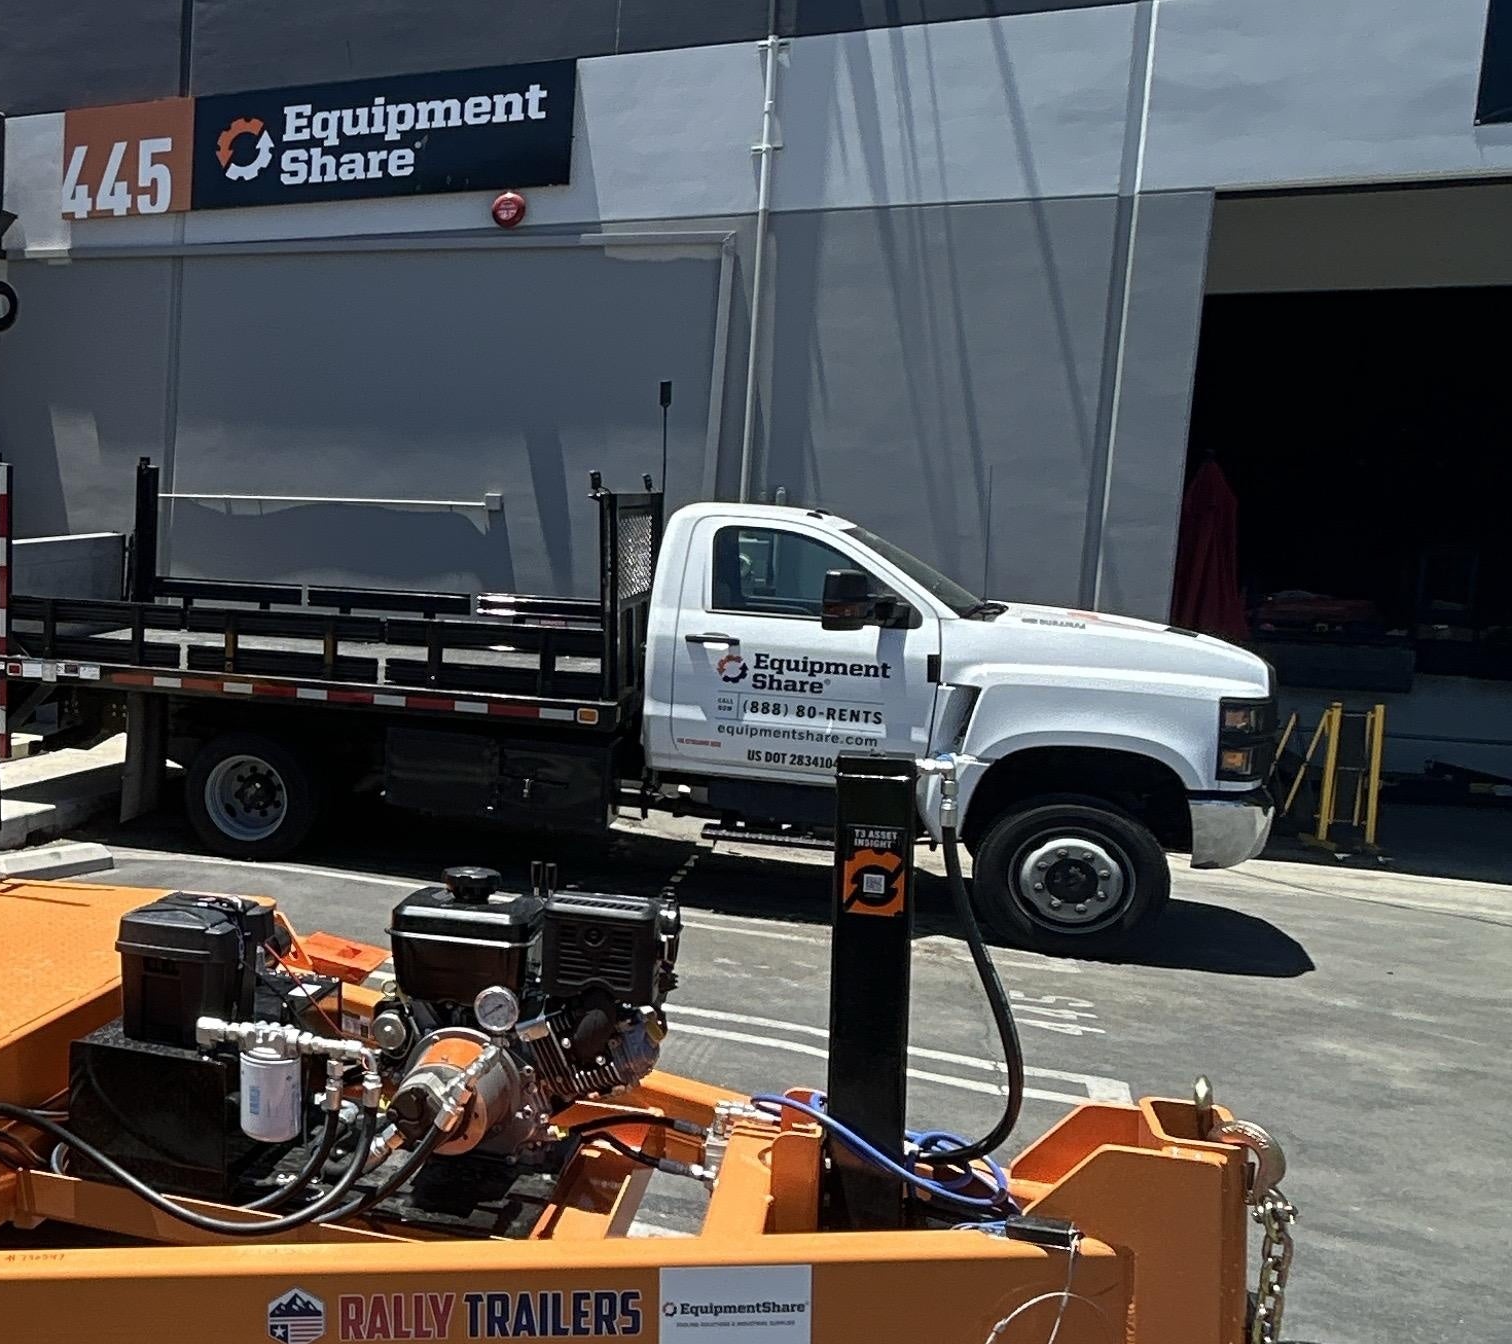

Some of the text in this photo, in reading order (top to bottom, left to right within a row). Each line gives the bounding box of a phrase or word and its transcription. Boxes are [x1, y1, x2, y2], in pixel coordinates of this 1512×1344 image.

[281, 83, 548, 147] Equipment
[61, 137, 173, 219] 445
[280, 145, 415, 186] Share
[753, 653, 892, 679] Equipment
[751, 673, 824, 694] Share
[743, 699, 883, 725] (888) 80-RENTS
[717, 723, 879, 748] equipmentshare.com
[747, 749, 762, 762] US
[765, 751, 788, 764] DOT
[338, 1289, 643, 1343] RALLY TRAILERS
[680, 1300, 806, 1317] EquipmentShare
